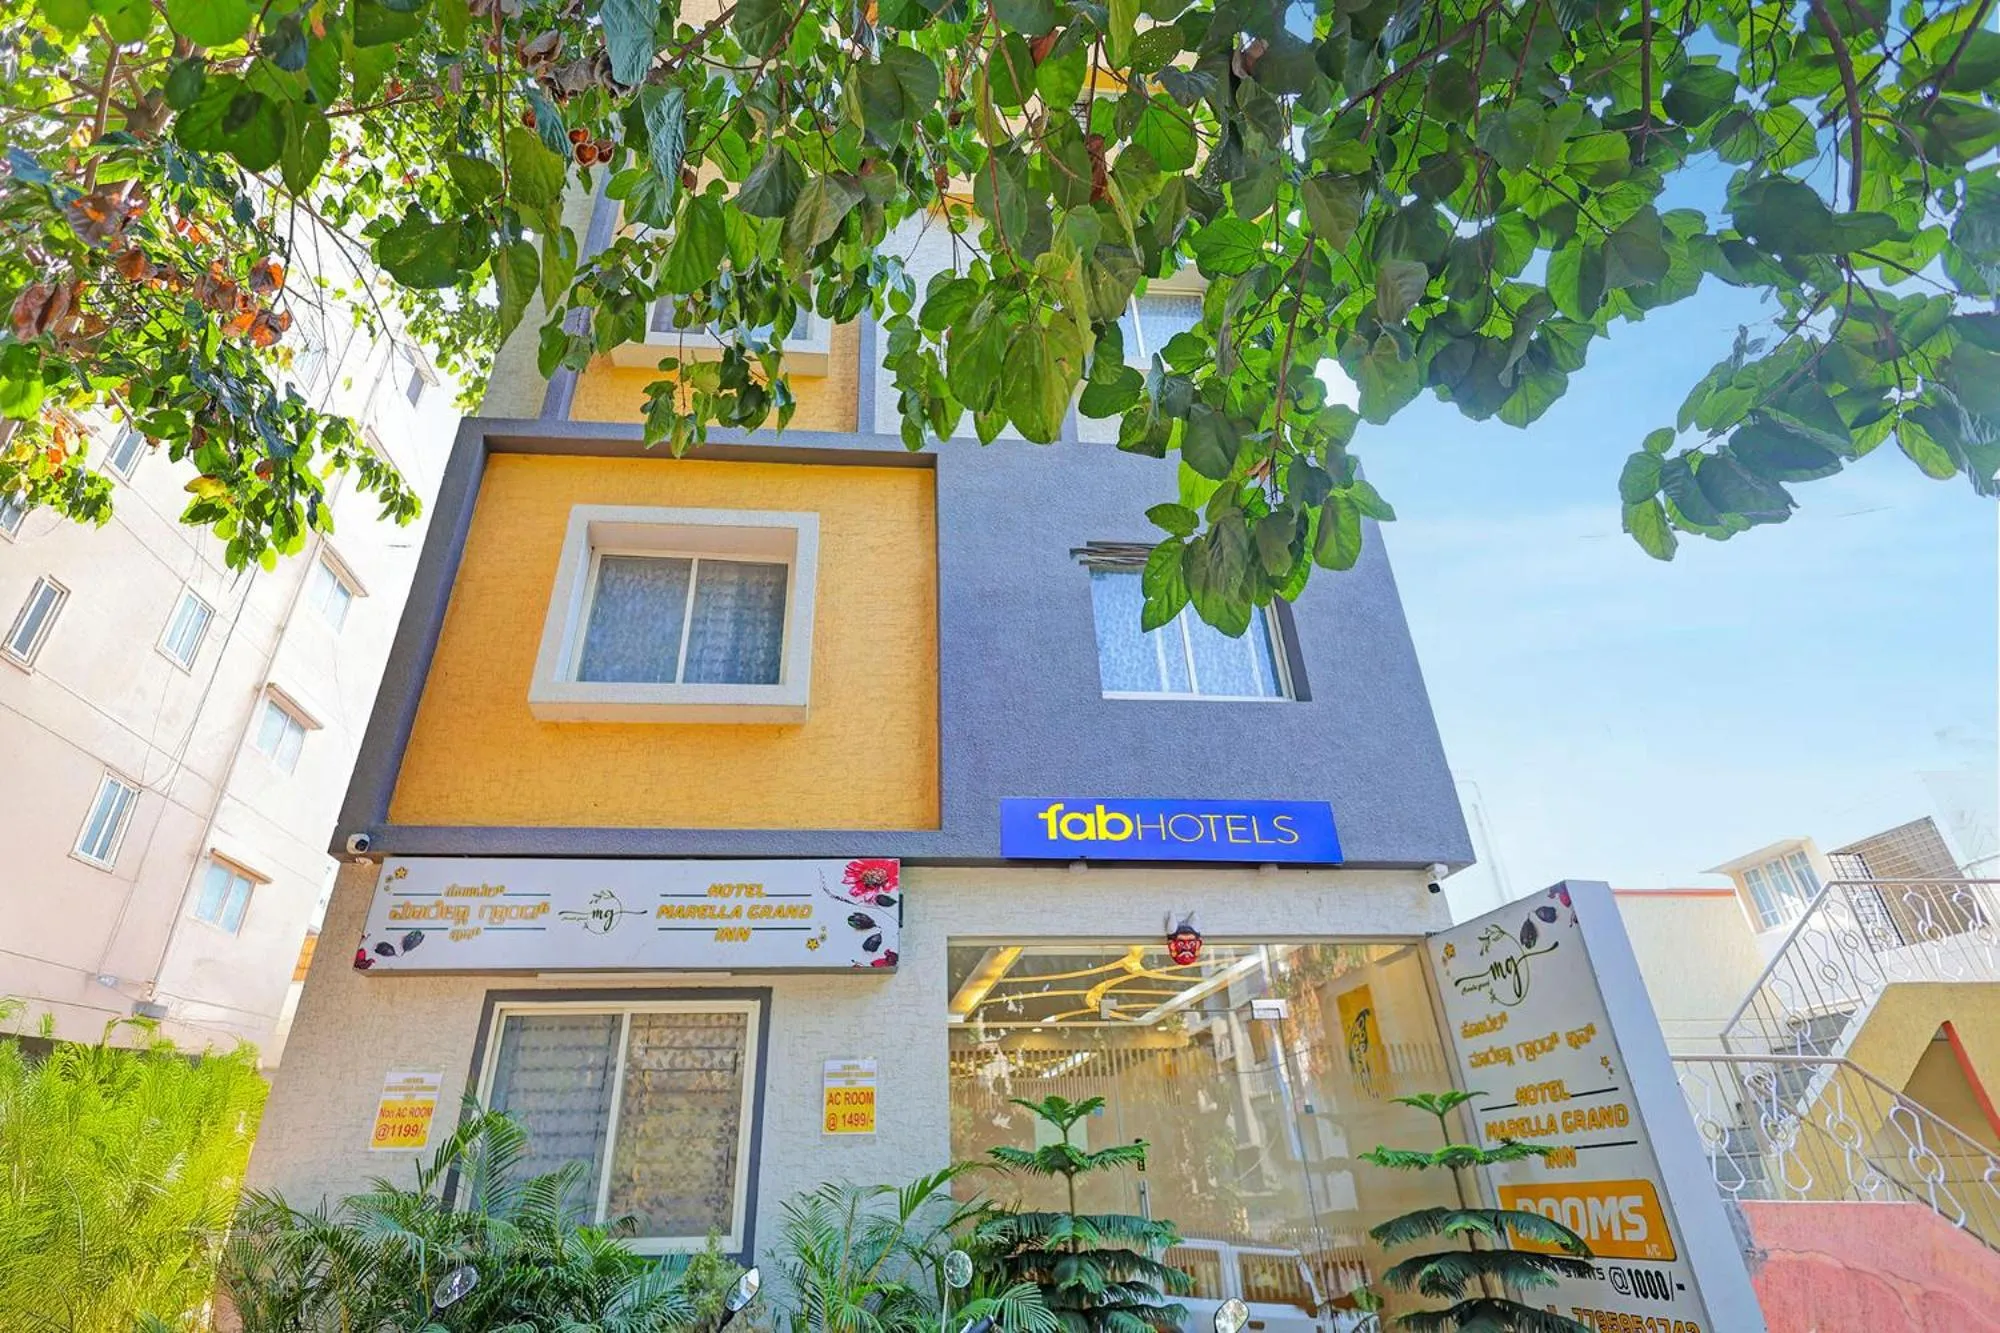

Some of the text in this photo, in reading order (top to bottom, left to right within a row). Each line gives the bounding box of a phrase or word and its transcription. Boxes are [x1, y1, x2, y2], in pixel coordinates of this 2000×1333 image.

[707, 883, 767, 898] HOTEL
[656, 904, 813, 919] MARELLA GRAND
[714, 926, 752, 942] INN
[827, 1092, 874, 1105] AC ROOM
[1515, 1079, 1572, 1107] HOTEL
[1485, 1103, 1629, 1142] MARELLA GRAND
[1544, 1145, 1577, 1169] INN
